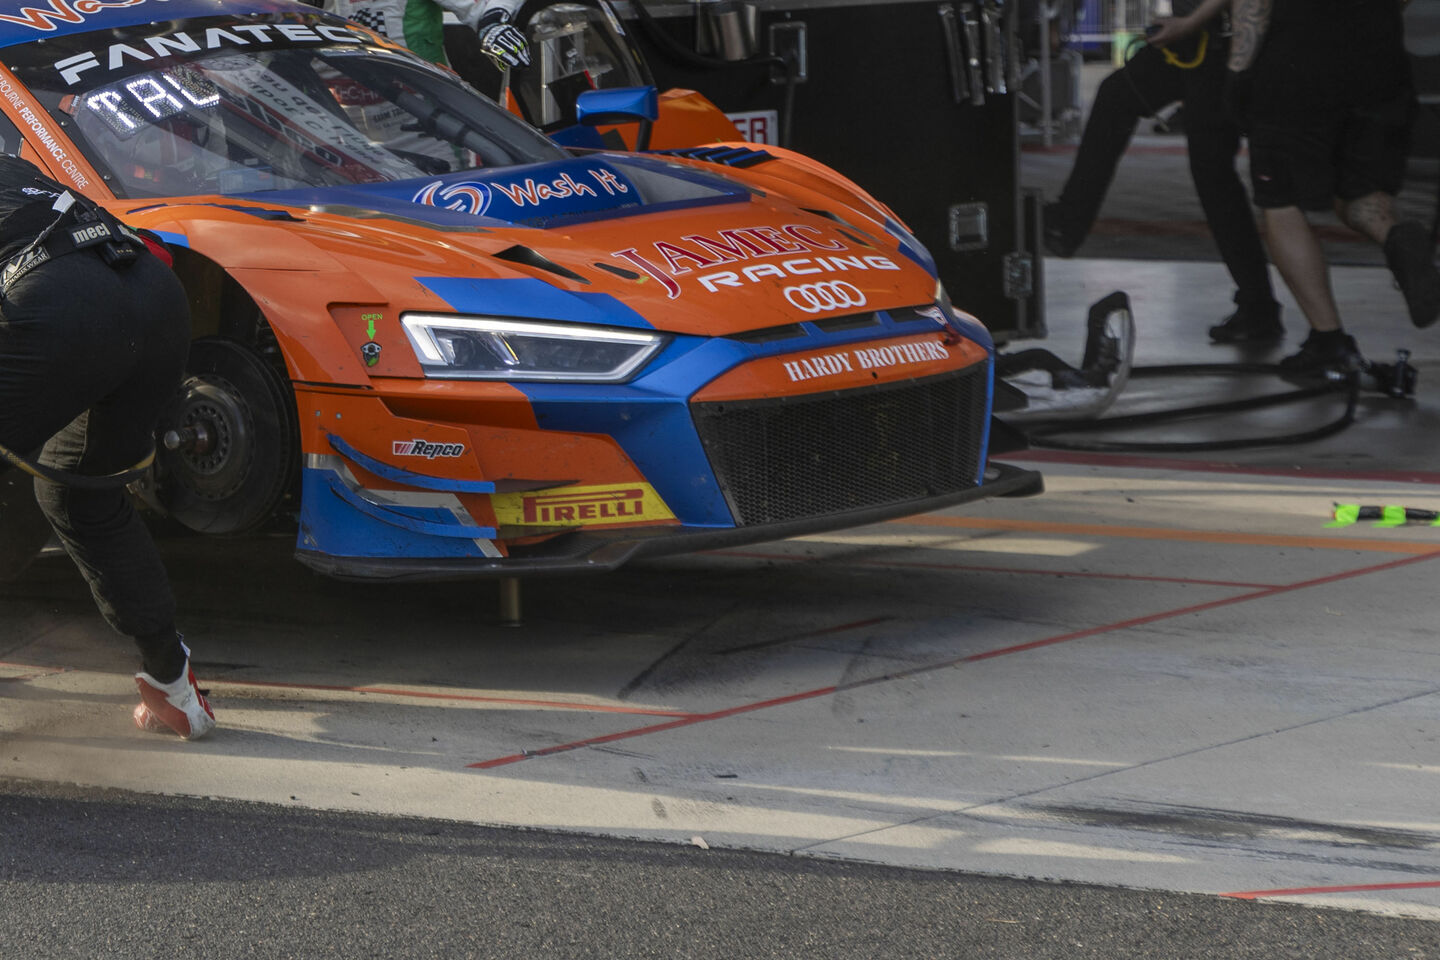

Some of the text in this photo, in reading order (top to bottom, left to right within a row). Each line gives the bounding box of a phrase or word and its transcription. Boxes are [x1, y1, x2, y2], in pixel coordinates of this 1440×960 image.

[54, 24, 361, 86] FANATEC
[19, 106, 67, 162] PERFORMANCE
[61, 159, 89, 189] CENTRE
[490, 168, 628, 207] Wash It
[611, 224, 848, 300] JAMEC
[697, 255, 901, 293] RACING
[361, 313, 383, 321] OPEN
[783, 340, 950, 382] HARDY BROTHERS
[411, 439, 464, 459] Repco
[523, 489, 644, 524] PIRELLI
